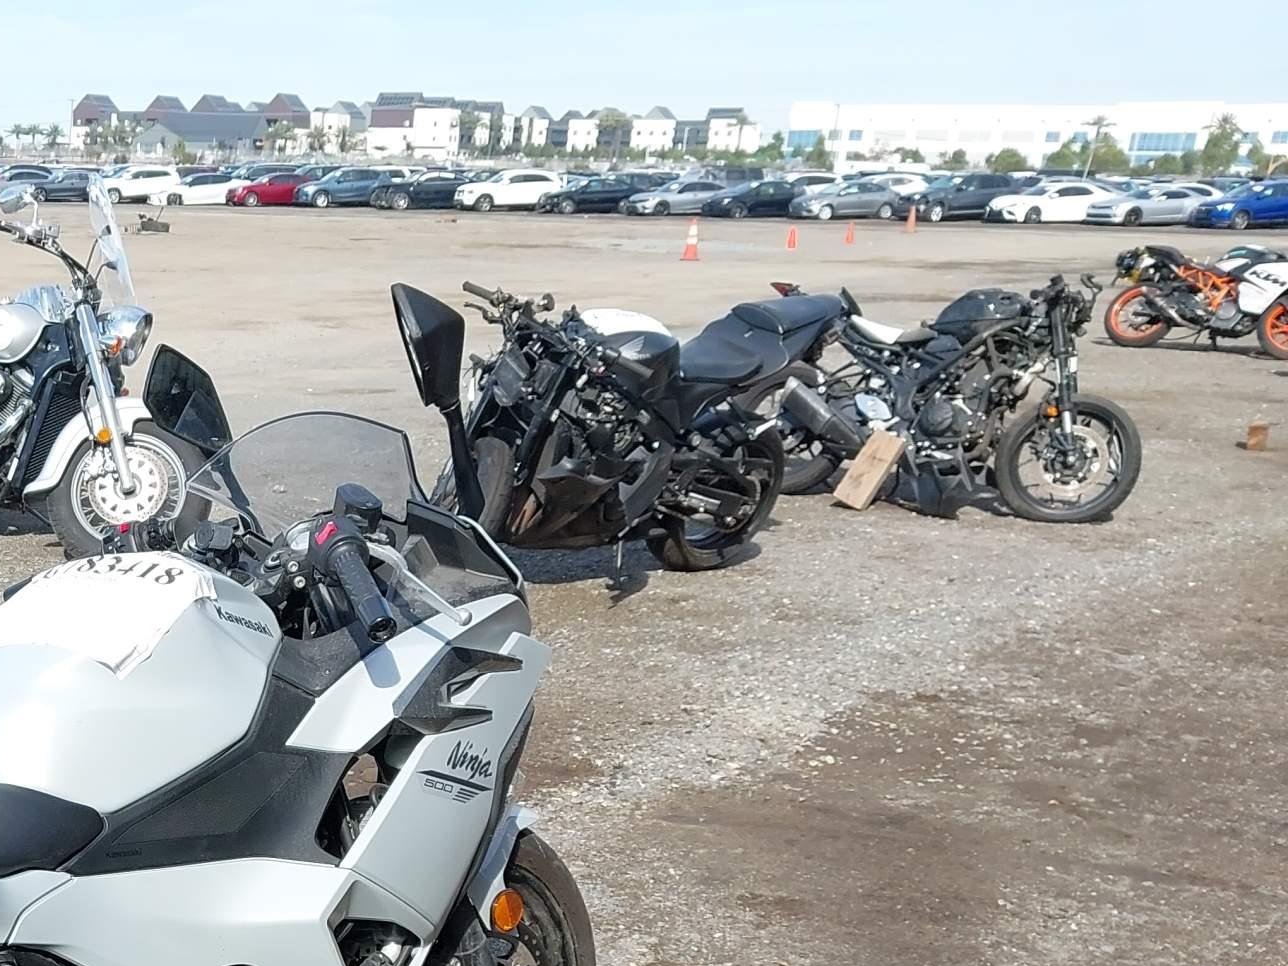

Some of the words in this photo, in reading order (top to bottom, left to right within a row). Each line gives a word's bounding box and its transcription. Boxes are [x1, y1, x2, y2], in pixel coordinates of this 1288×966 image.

[215, 605, 273, 637] Kawasaki
[447, 740, 493, 780] Ninja
[424, 779, 454, 793] 500
